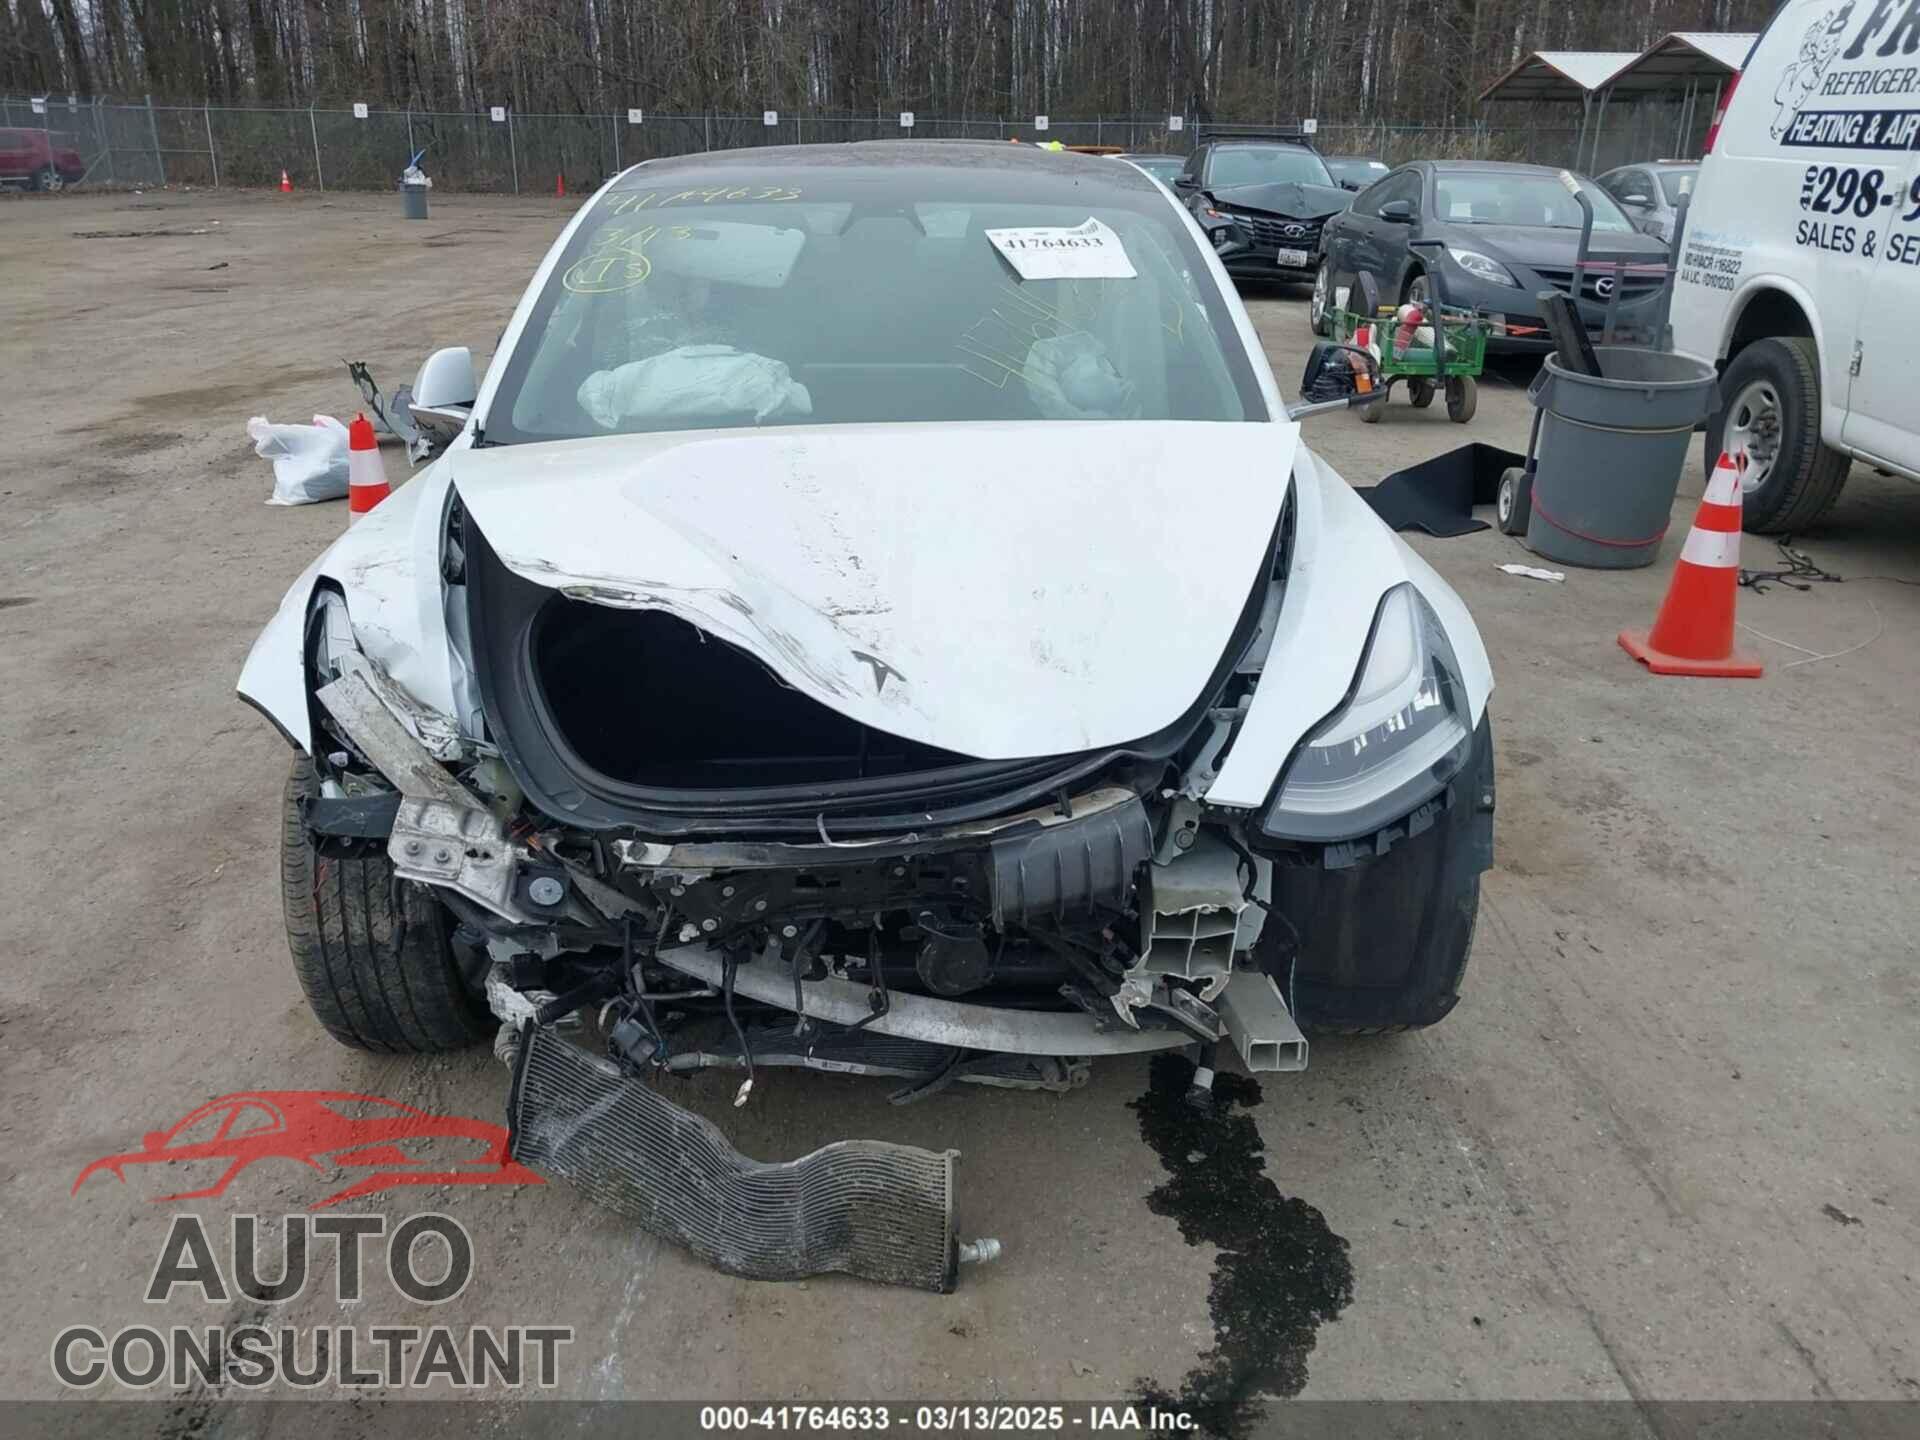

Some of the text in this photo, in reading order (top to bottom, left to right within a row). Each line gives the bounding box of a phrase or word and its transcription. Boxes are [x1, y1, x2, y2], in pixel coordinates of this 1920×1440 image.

[1788, 113, 1864, 143] HEATING
[1862, 113, 1882, 144] &
[1800, 165, 1818, 211] 410
[1004, 237, 1104, 249] 41764633
[1796, 219, 1920, 266] SALES & SE
